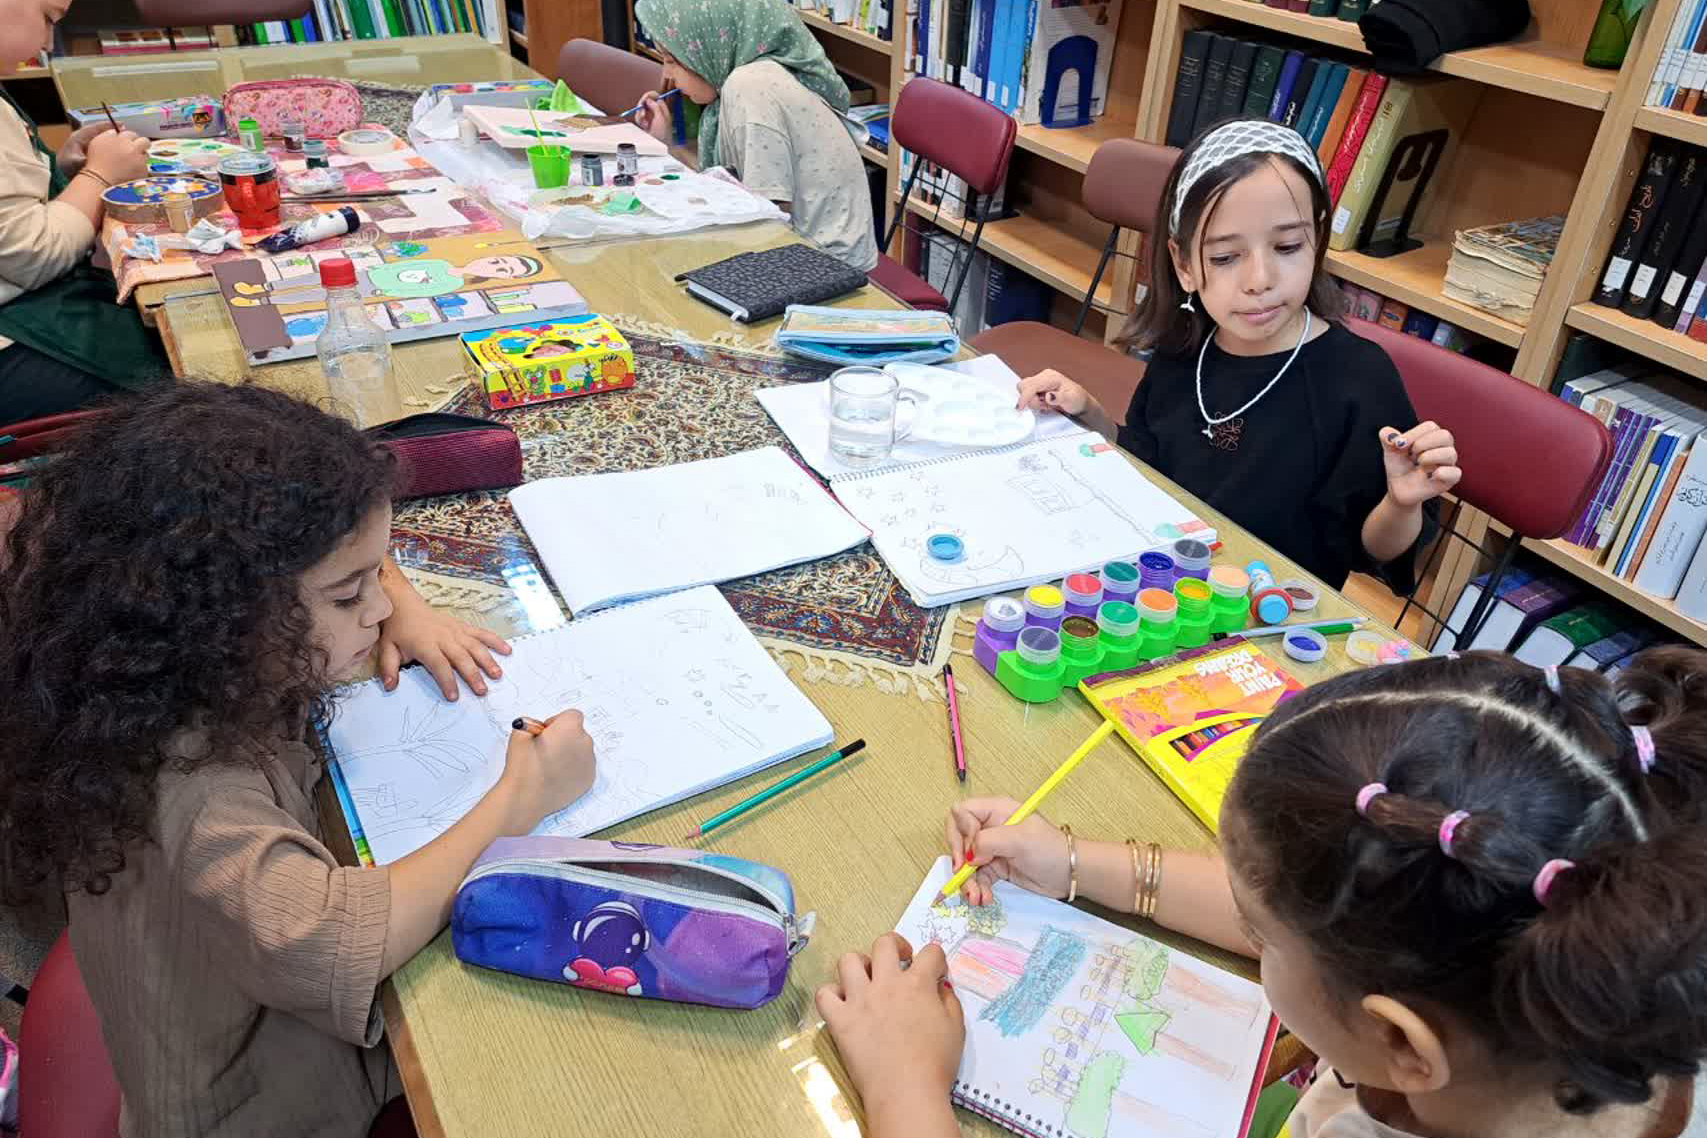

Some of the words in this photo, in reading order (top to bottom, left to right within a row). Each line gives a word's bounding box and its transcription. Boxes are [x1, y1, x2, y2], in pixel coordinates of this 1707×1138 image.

[1193, 648, 1254, 677] DREAMS
[1225, 660, 1266, 683] YOUR
[1239, 672, 1284, 698] PAINT
